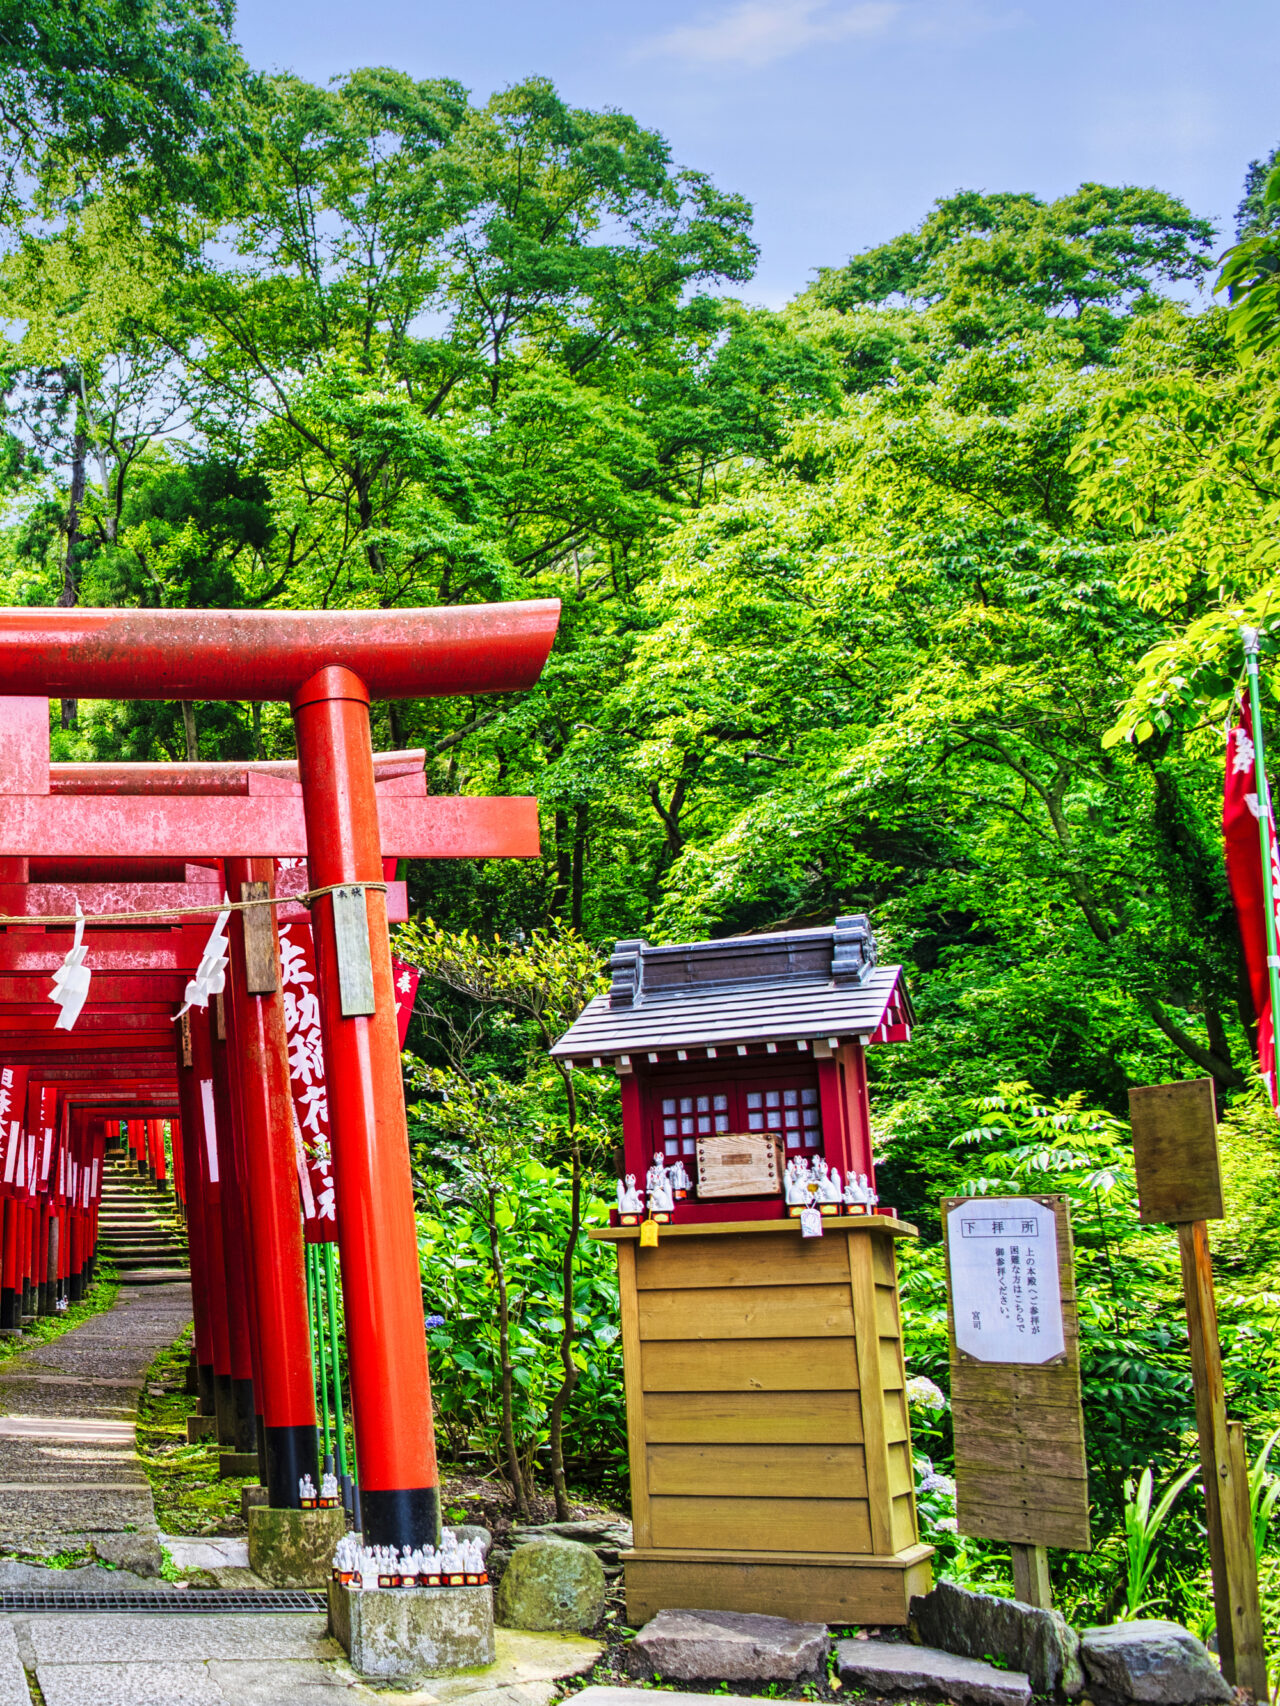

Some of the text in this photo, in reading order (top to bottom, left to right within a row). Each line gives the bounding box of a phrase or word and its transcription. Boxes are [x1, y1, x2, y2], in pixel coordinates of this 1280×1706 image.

[965, 1220, 1034, 1234] 下拝所
[995, 1247, 1010, 1319] 御参拝ください。
[1010, 1245, 1025, 1333] 困難な方はこちらで
[1026, 1247, 1040, 1335] 上の本殿へご参拝が
[971, 1311, 981, 1330] 宮司
